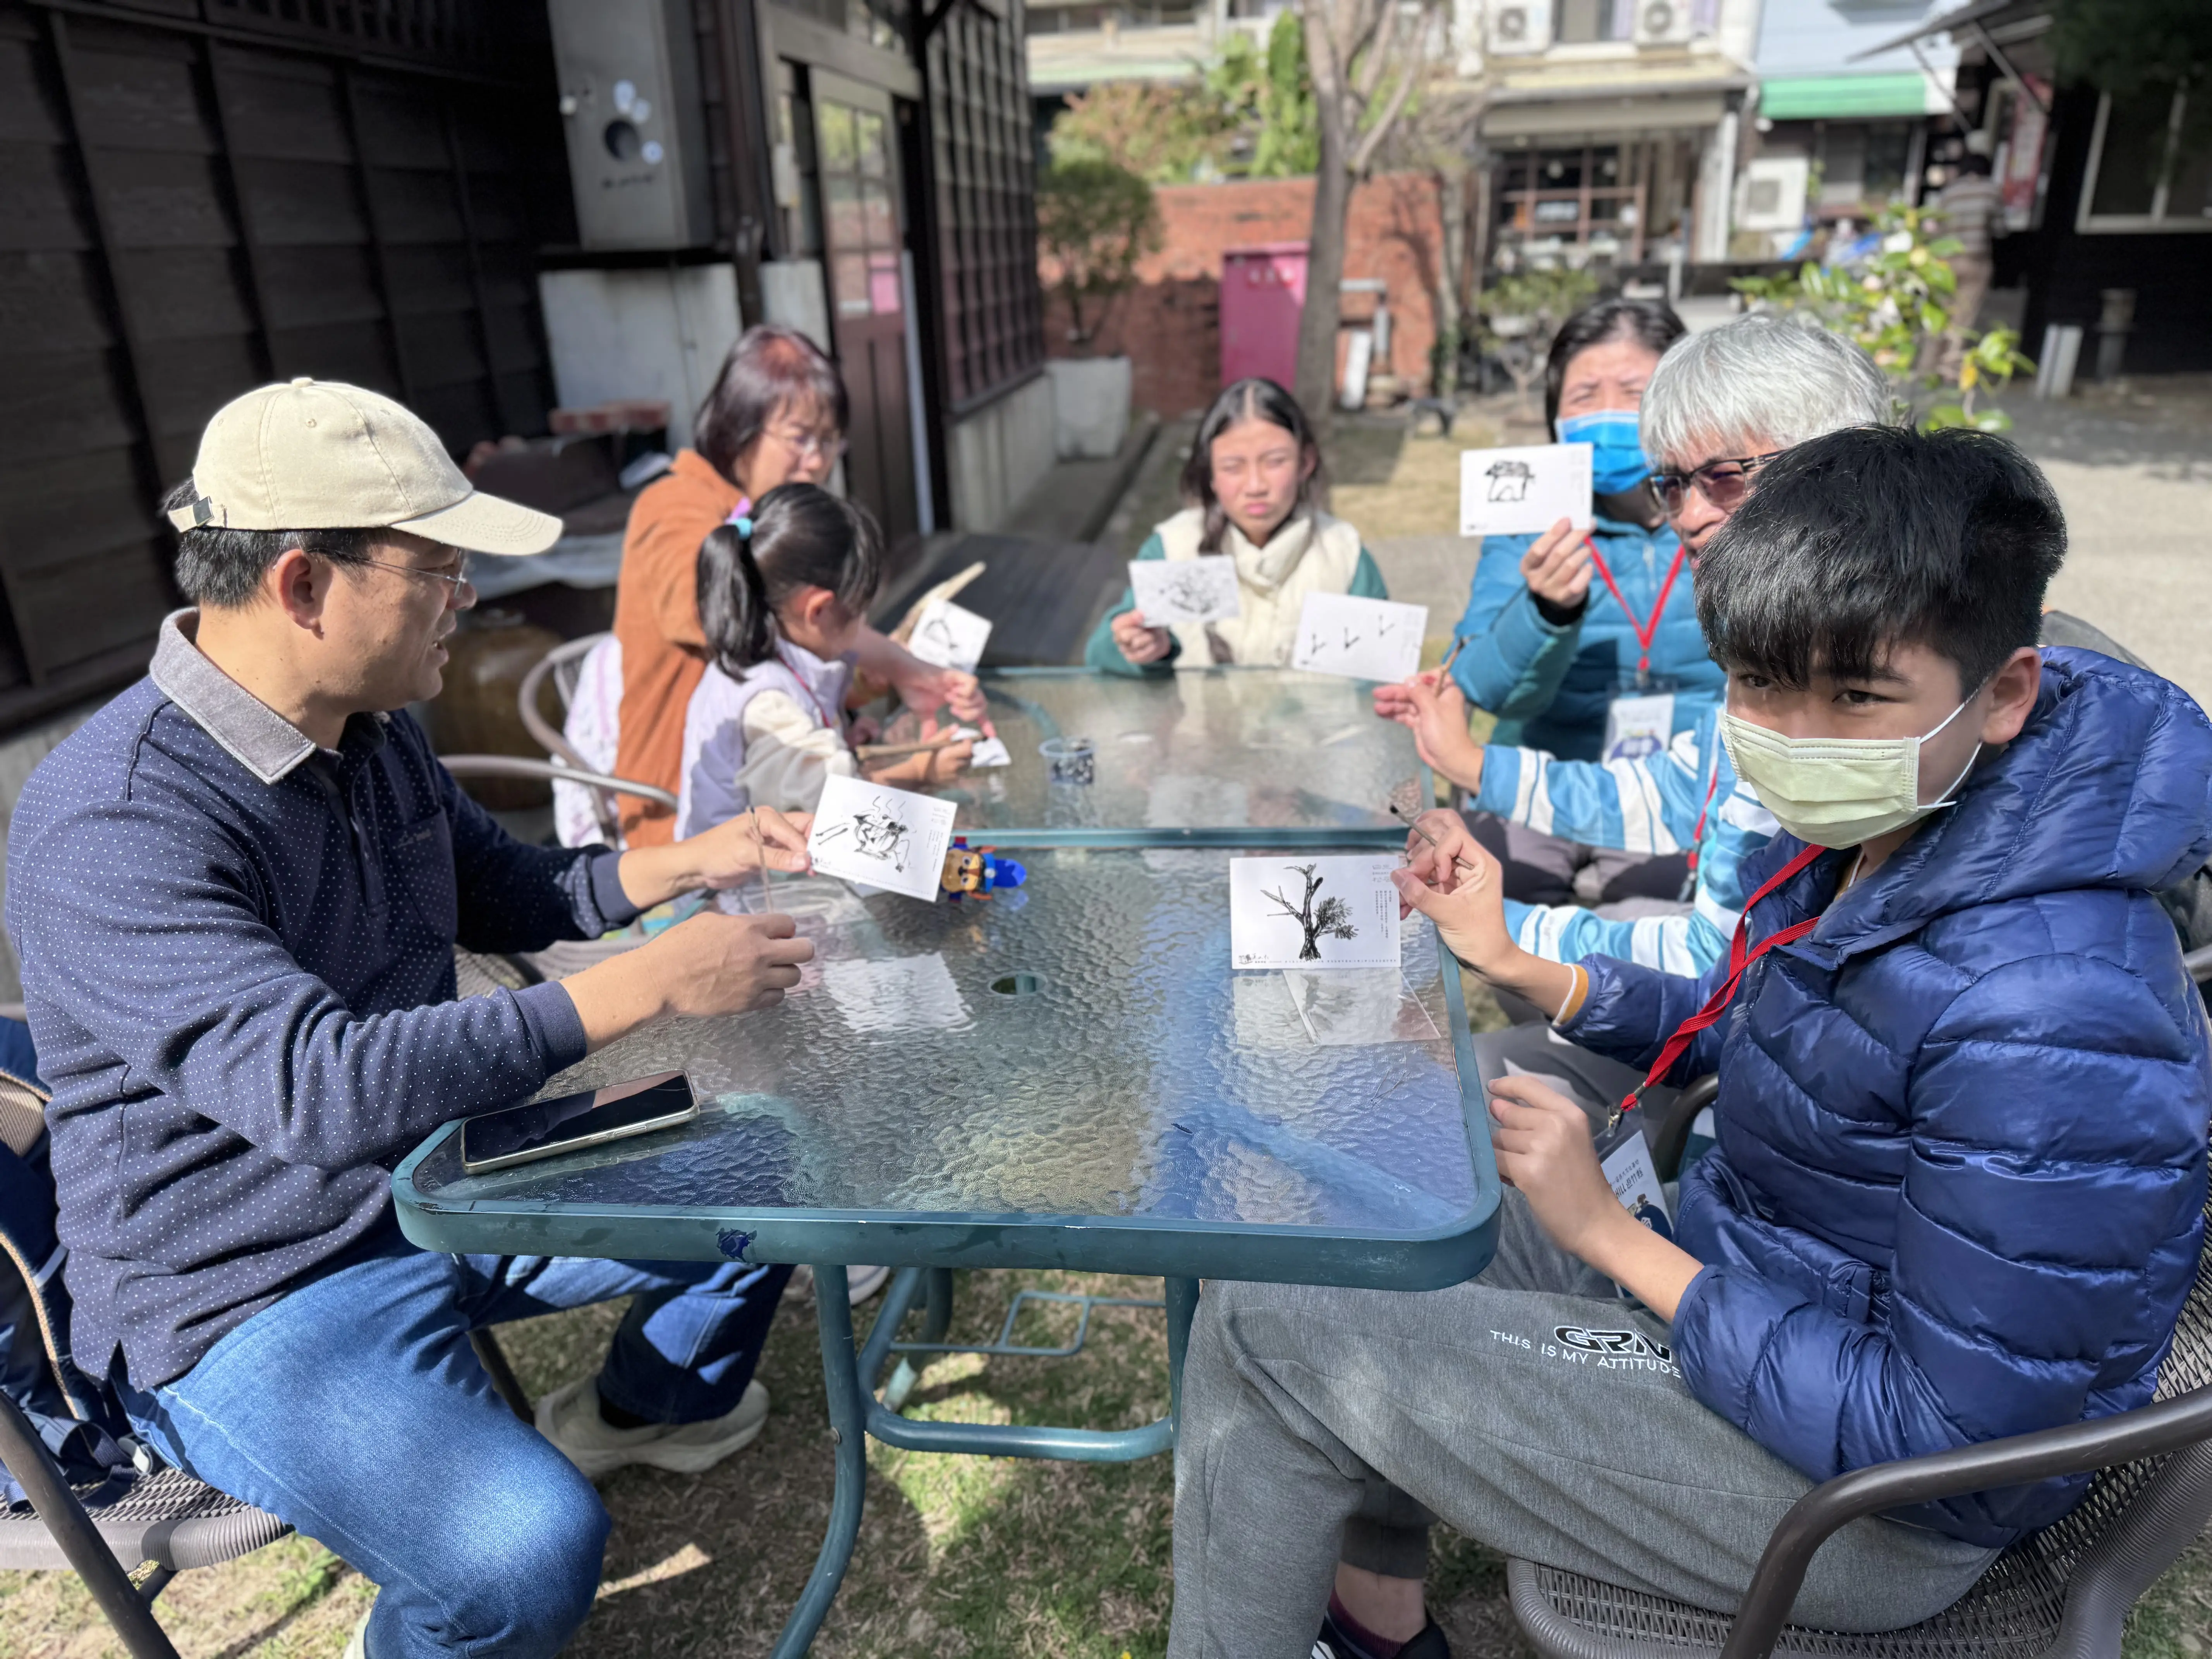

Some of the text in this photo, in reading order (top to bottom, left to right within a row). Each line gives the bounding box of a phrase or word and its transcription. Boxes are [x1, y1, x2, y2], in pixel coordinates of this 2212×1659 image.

[1490, 1330, 1681, 1379] THIS IS MY ATTITUDE
